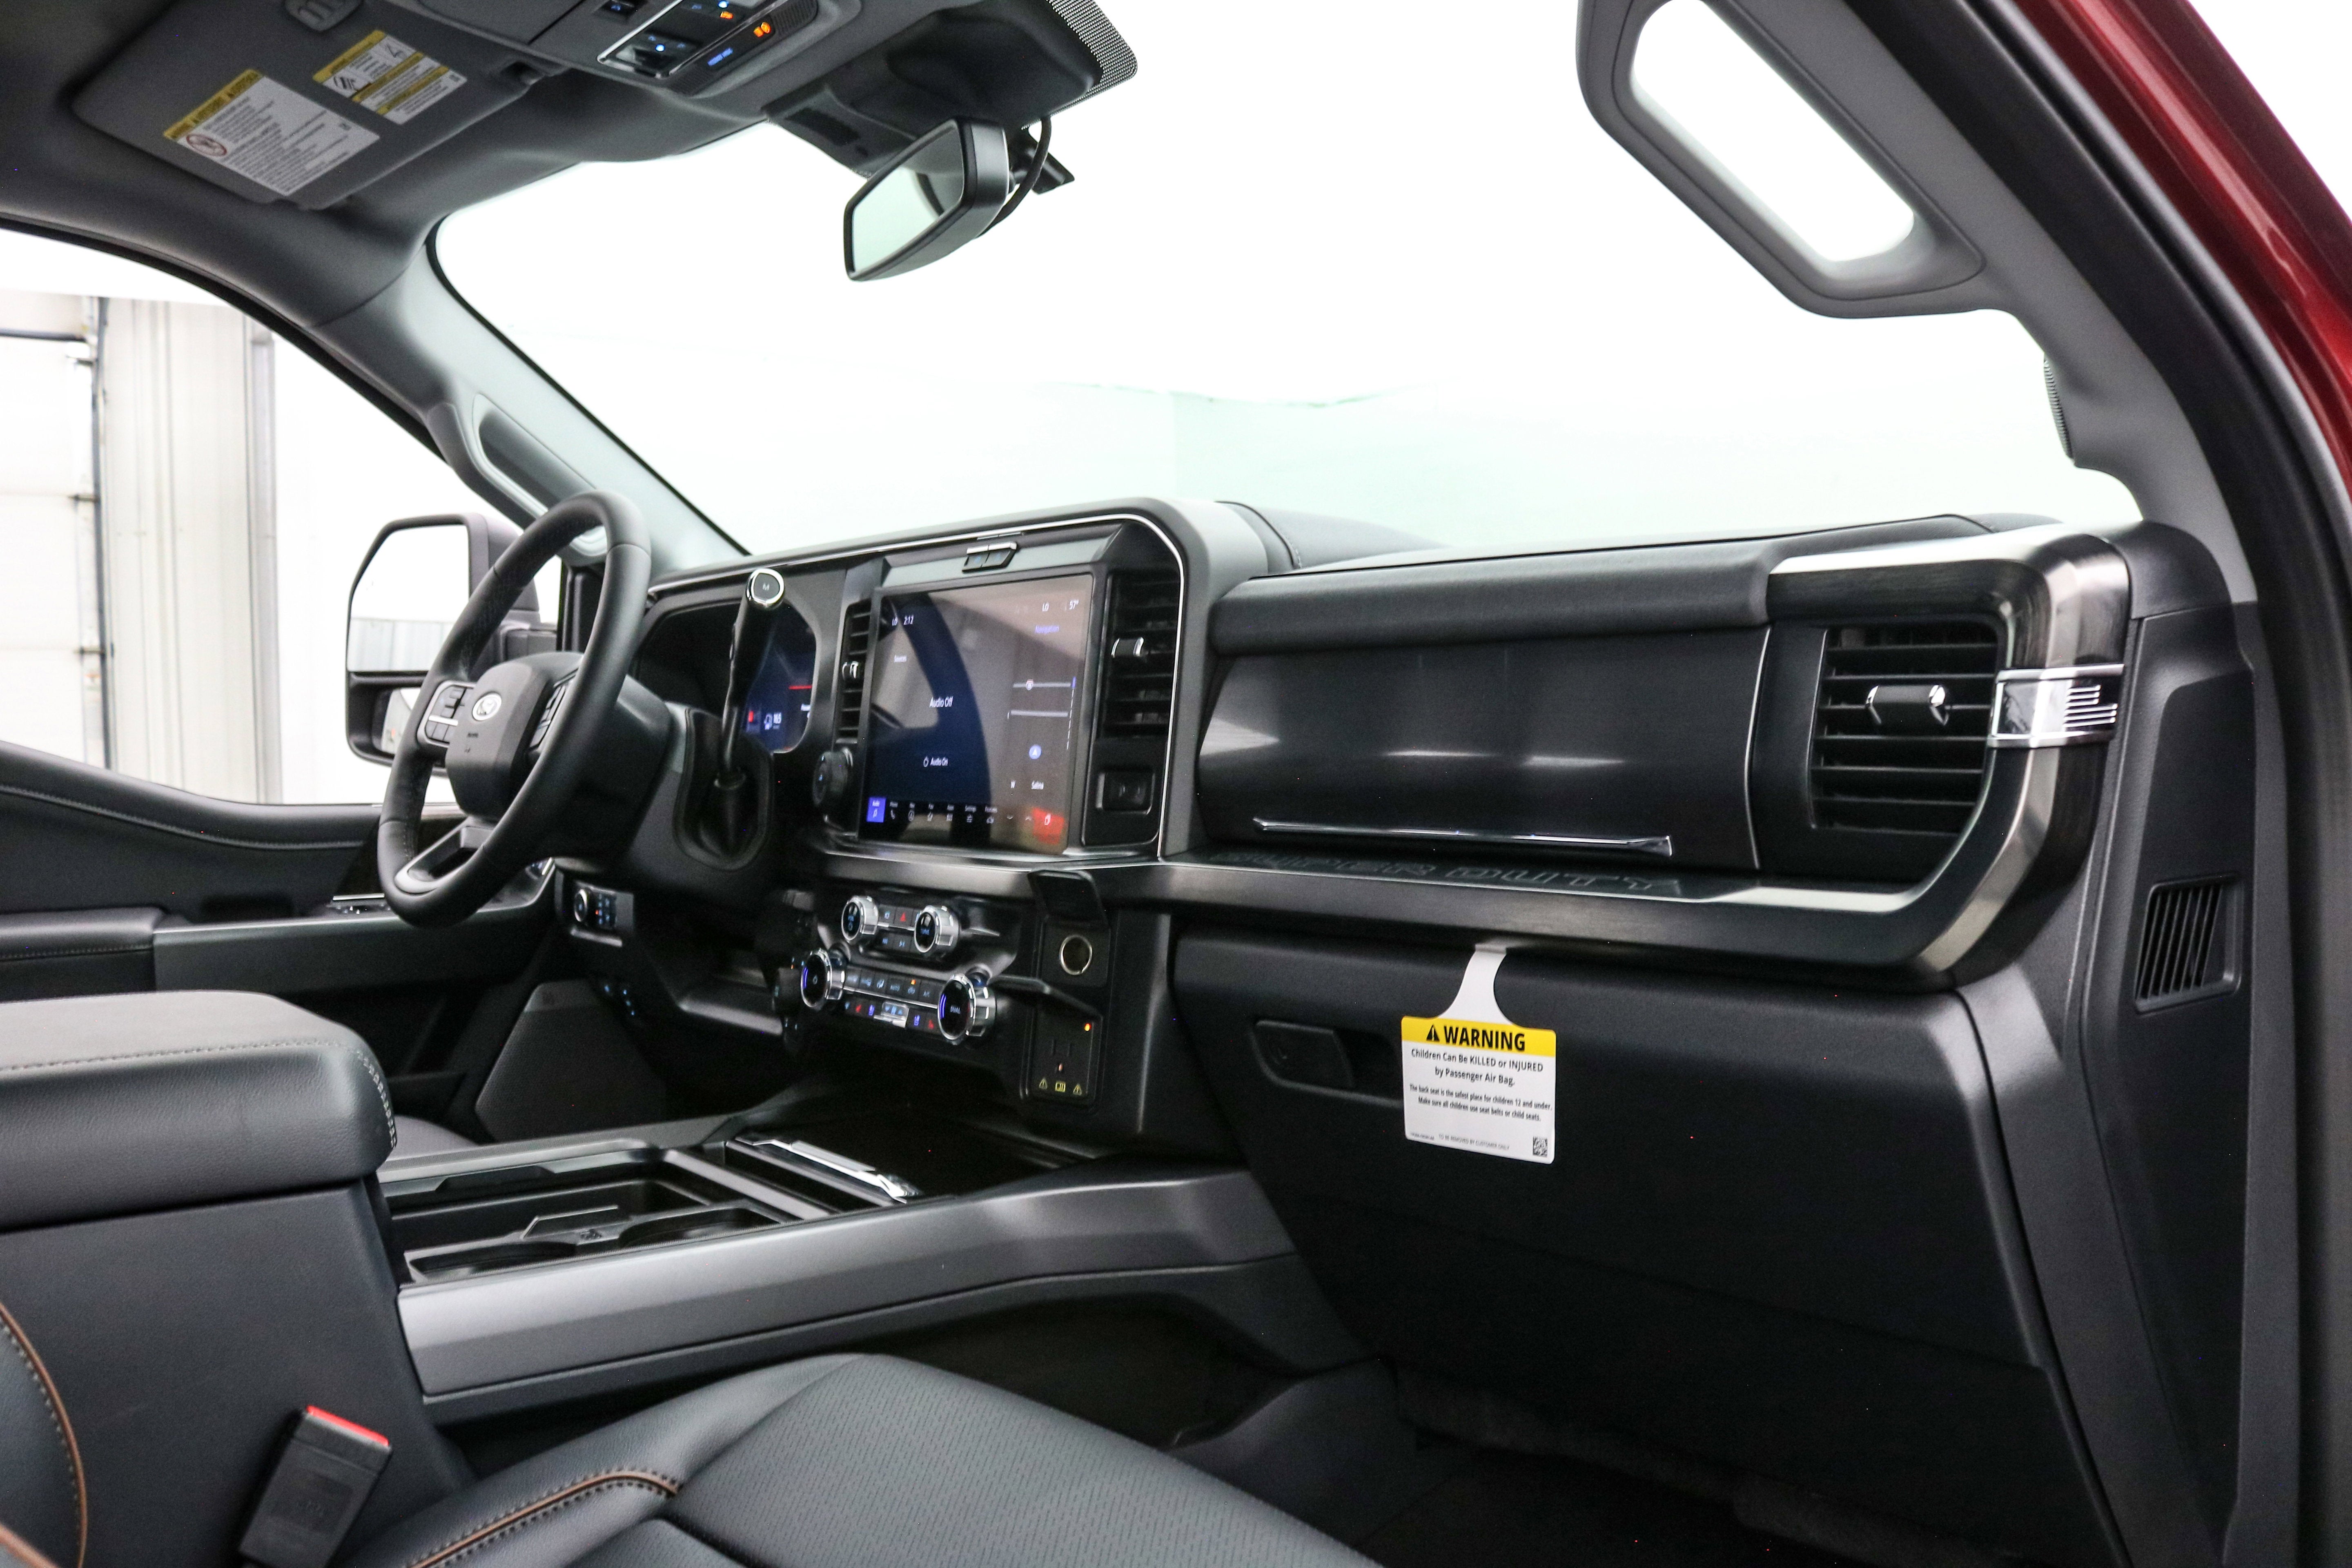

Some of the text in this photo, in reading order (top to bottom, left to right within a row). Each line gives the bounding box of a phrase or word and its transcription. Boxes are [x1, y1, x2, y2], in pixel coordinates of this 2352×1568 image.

[1042, 602, 1049, 612] LO
[929, 696, 953, 708] Audio Off
[930, 757, 948, 766] Audio On
[1445, 866, 1677, 891] DUTY
[950, 1006, 961, 1014] DUAL
[1443, 1025, 1525, 1051] WARNING
[1411, 1048, 1441, 1060] Children
[1443, 1052, 1457, 1062] Can
[1459, 1054, 1468, 1063] Be
[1470, 1055, 1496, 1067] KILLED
[1509, 1059, 1544, 1072] INJURED
[1435, 1066, 1443, 1078] by
[1446, 1068, 1483, 1082] Passenger
[1485, 1073, 1496, 1082] Air
[1410, 1083, 1418, 1092] The
[1419, 1084, 1429, 1093] back
[1441, 1088, 1445, 1096] is
[1455, 1090, 1469, 1100] safest
[1470, 1092, 1483, 1101] place
[1492, 1095, 1513, 1105] children
[1515, 1098, 1521, 1107] 12
[1534, 1101, 1552, 1111] under.
[1419, 1096, 1430, 1105] Make
[1450, 1101, 1469, 1111] children
[1479, 1106, 1490, 1115] seat
[1491, 1107, 1503, 1116] belts
[1512, 1110, 1525, 1120] child
[1526, 1114, 1541, 1122] seats.
